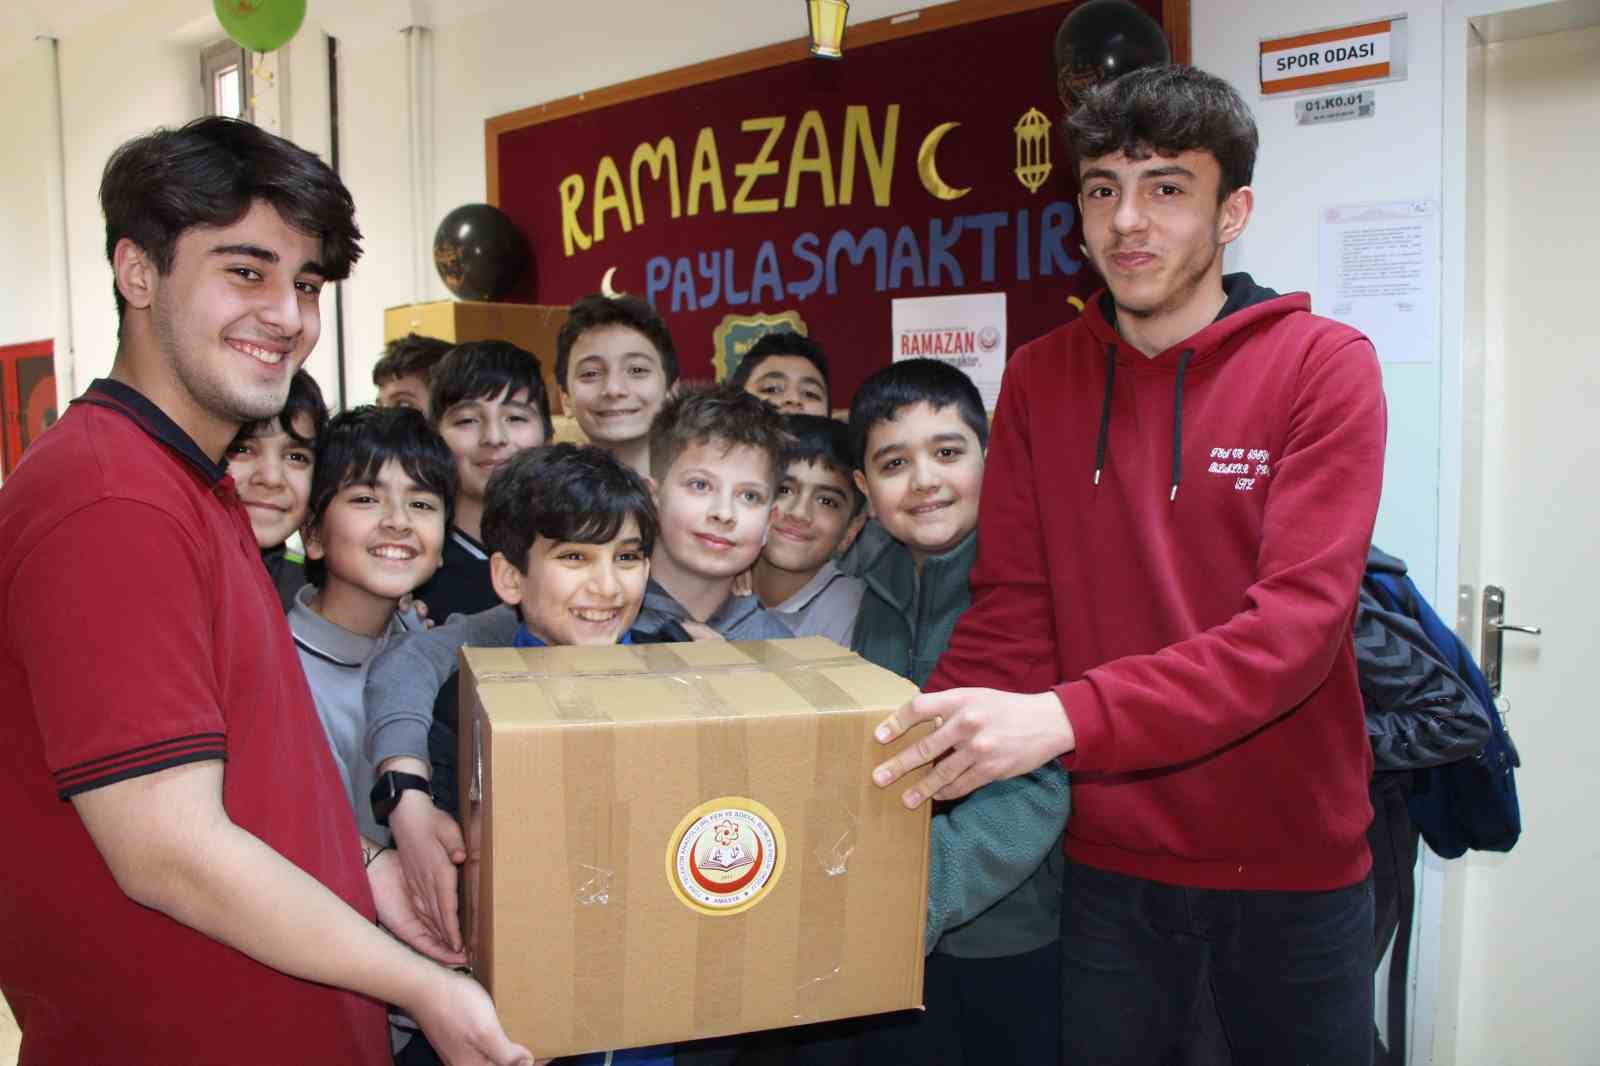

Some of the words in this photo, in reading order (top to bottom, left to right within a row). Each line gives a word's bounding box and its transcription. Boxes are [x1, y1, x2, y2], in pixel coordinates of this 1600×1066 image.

[1276, 52, 1320, 72] SPOR
[1324, 42, 1375, 64] ODASI
[559, 103, 900, 256] RAMAZAN
[645, 201, 1083, 312] PAYLAŞMAKTIR
[900, 331, 975, 355] RAMAZAN
